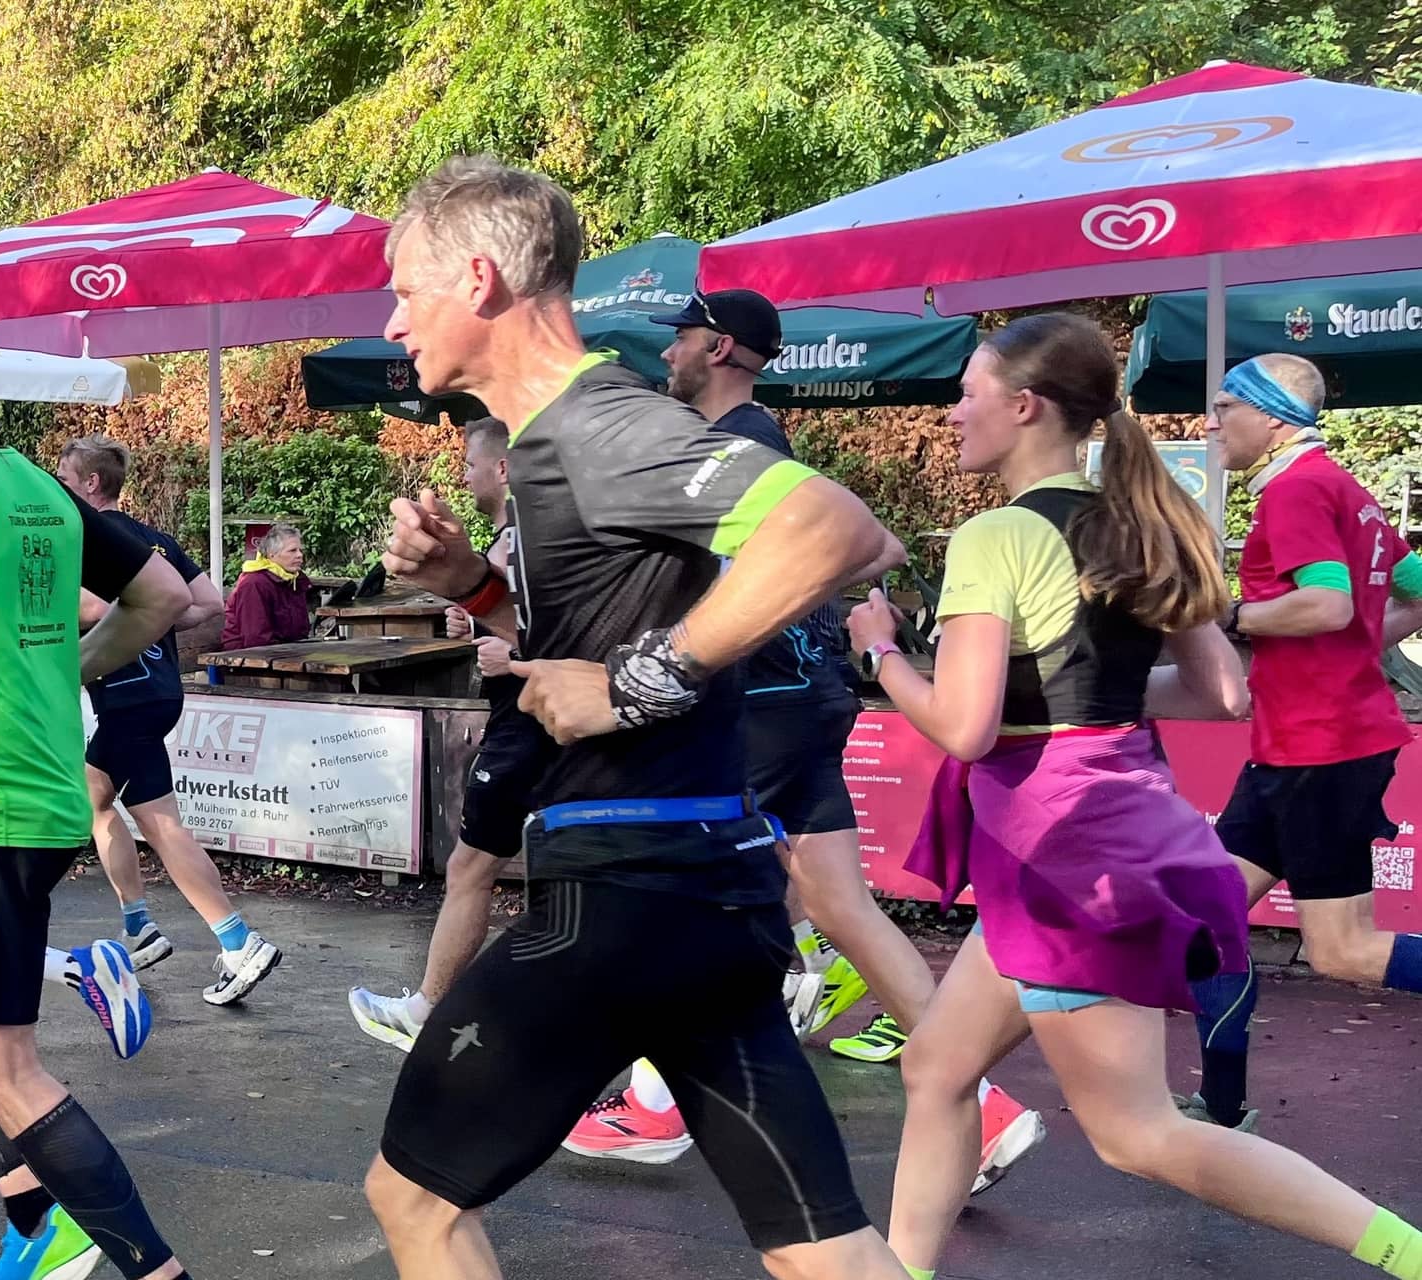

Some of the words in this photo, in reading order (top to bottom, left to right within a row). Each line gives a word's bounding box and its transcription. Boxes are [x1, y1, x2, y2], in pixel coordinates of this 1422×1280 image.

[1328, 297, 1422, 338] Staude
[165, 711, 261, 752] IKE
[320, 726, 386, 745] Inspektionen
[178, 749, 251, 763] RVICE
[319, 748, 389, 768] Reifenservice
[175, 775, 289, 804] dwerkstatt
[319, 778, 340, 791] TÜV
[194, 801, 237, 816] Mülheim
[263, 810, 289, 822] Ruhr
[318, 792, 408, 815] Fahrwerksservice
[188, 815, 206, 827] 899
[208, 818, 233, 829] 2767
